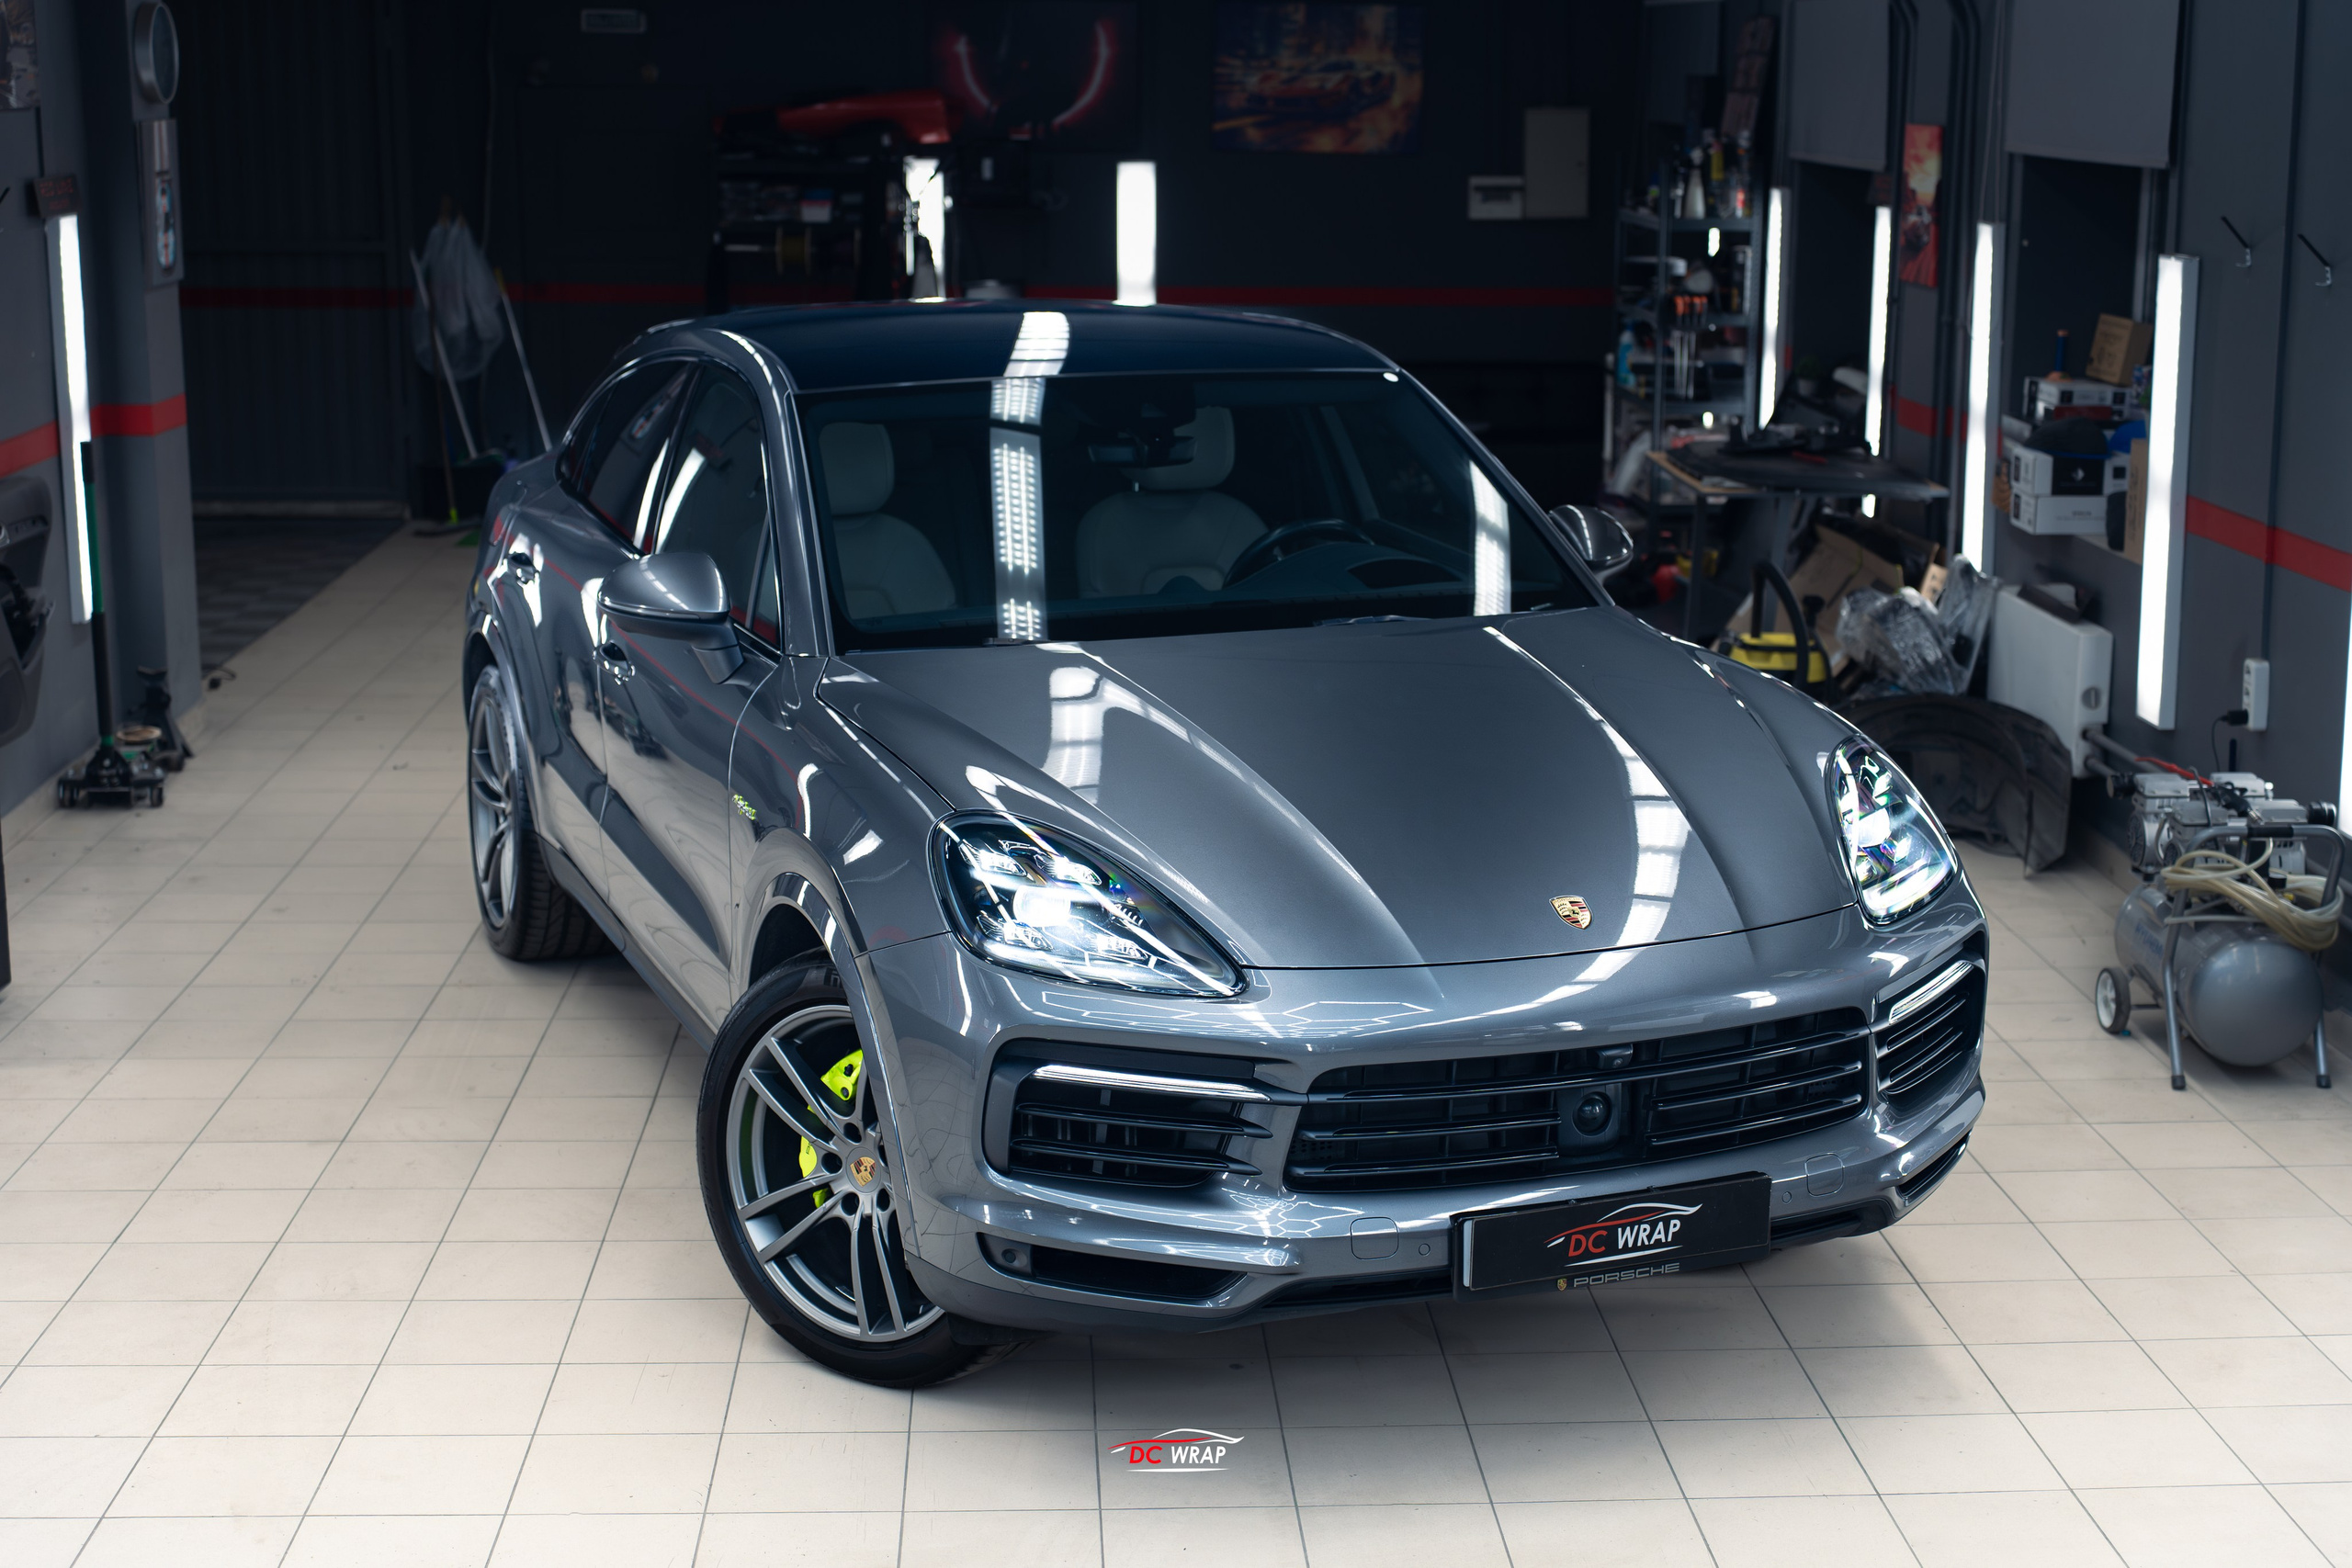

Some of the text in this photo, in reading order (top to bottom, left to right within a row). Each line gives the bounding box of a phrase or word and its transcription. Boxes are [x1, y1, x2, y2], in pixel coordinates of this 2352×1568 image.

[1567, 1219, 1681, 1258] DC WRAP
[1573, 1262, 1680, 1288] PORSCHE
